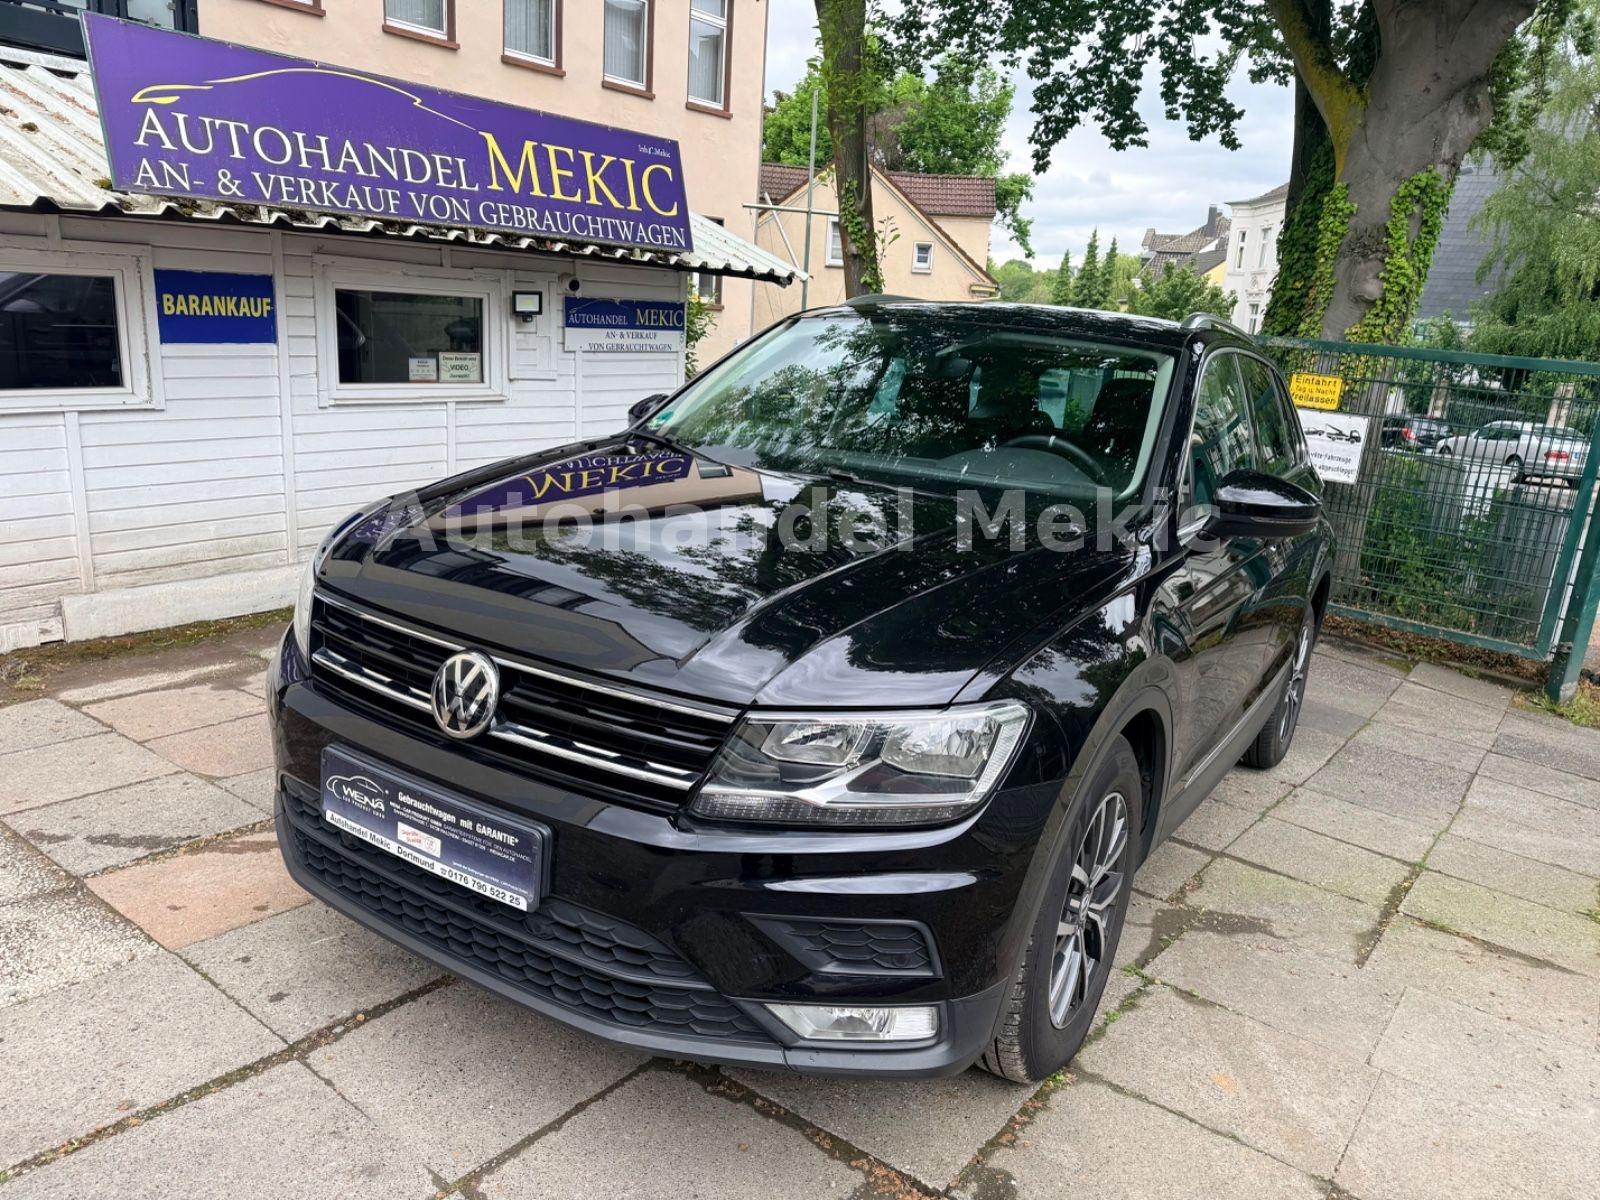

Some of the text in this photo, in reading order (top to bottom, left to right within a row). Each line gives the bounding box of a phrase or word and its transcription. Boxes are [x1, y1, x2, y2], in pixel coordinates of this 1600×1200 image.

[134, 108, 678, 217] AUTOHANDEL MEKIC
[134, 158, 686, 247] AN- & VERKAUF VON GEBRAUCHTWAGEN
[162, 293, 271, 318] BARANKAUF
[569, 308, 684, 327] AUTOHANDEL MEKIC
[605, 331, 657, 340] AN- & VERKAUF
[589, 343, 672, 351] VON GEBRAUCHTWAGEN
[1296, 376, 1337, 388] Einfahrt
[1316, 387, 1336, 396] Nacht
[398, 791, 456, 823] Gebrauchtwagen
[460, 819, 473, 830] mit
[330, 813, 368, 838] Autohandel
[369, 833, 391, 850] Mekic
[397, 846, 435, 870] Dortmund
[448, 869, 469, 885] 0176
[471, 879, 487, 893] 790
[490, 886, 506, 900] 522
[509, 894, 521, 906] 25
